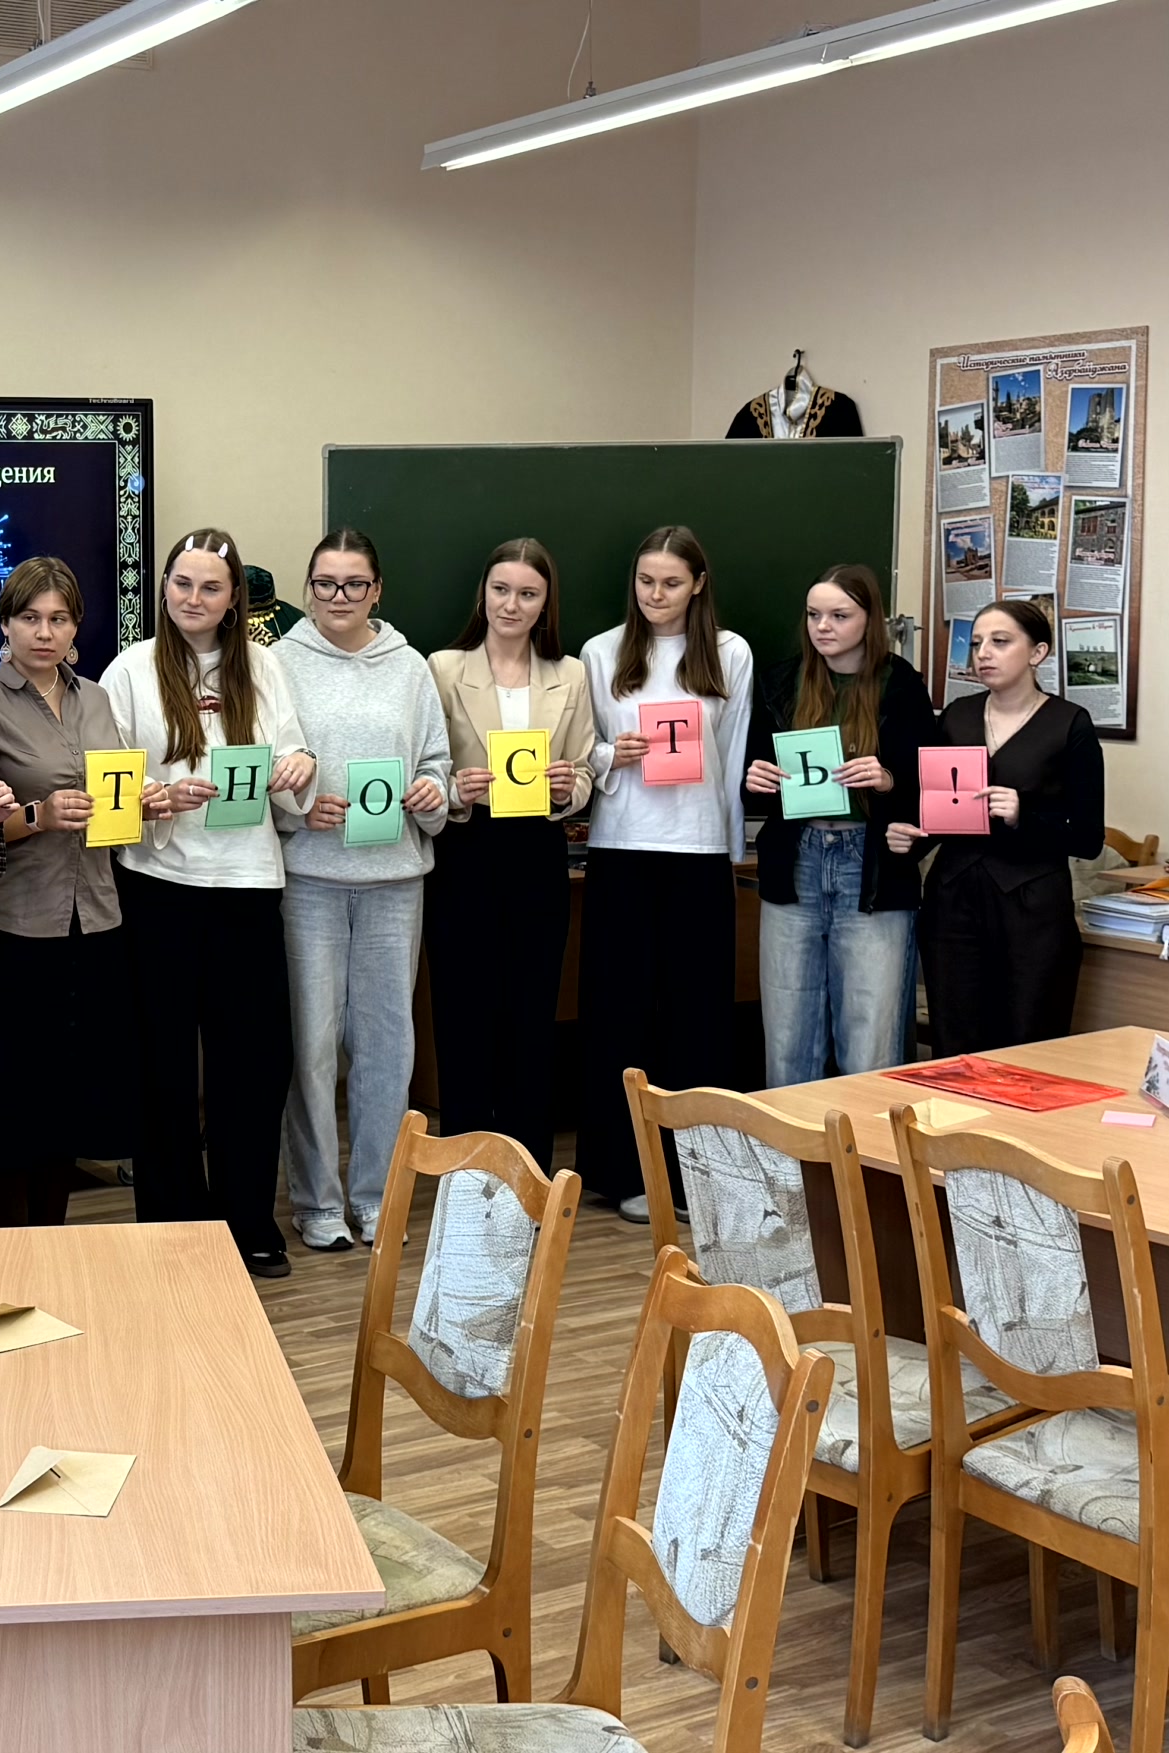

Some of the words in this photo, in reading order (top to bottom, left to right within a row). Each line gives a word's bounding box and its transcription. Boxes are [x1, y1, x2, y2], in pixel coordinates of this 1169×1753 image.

[656, 719, 689, 754] Т
[222, 765, 262, 802] Н
[505, 748, 538, 786] С
[796, 750, 829, 788] Ь
[950, 766, 959, 805] !
[102, 770, 133, 811] Т
[359, 778, 393, 816] О
